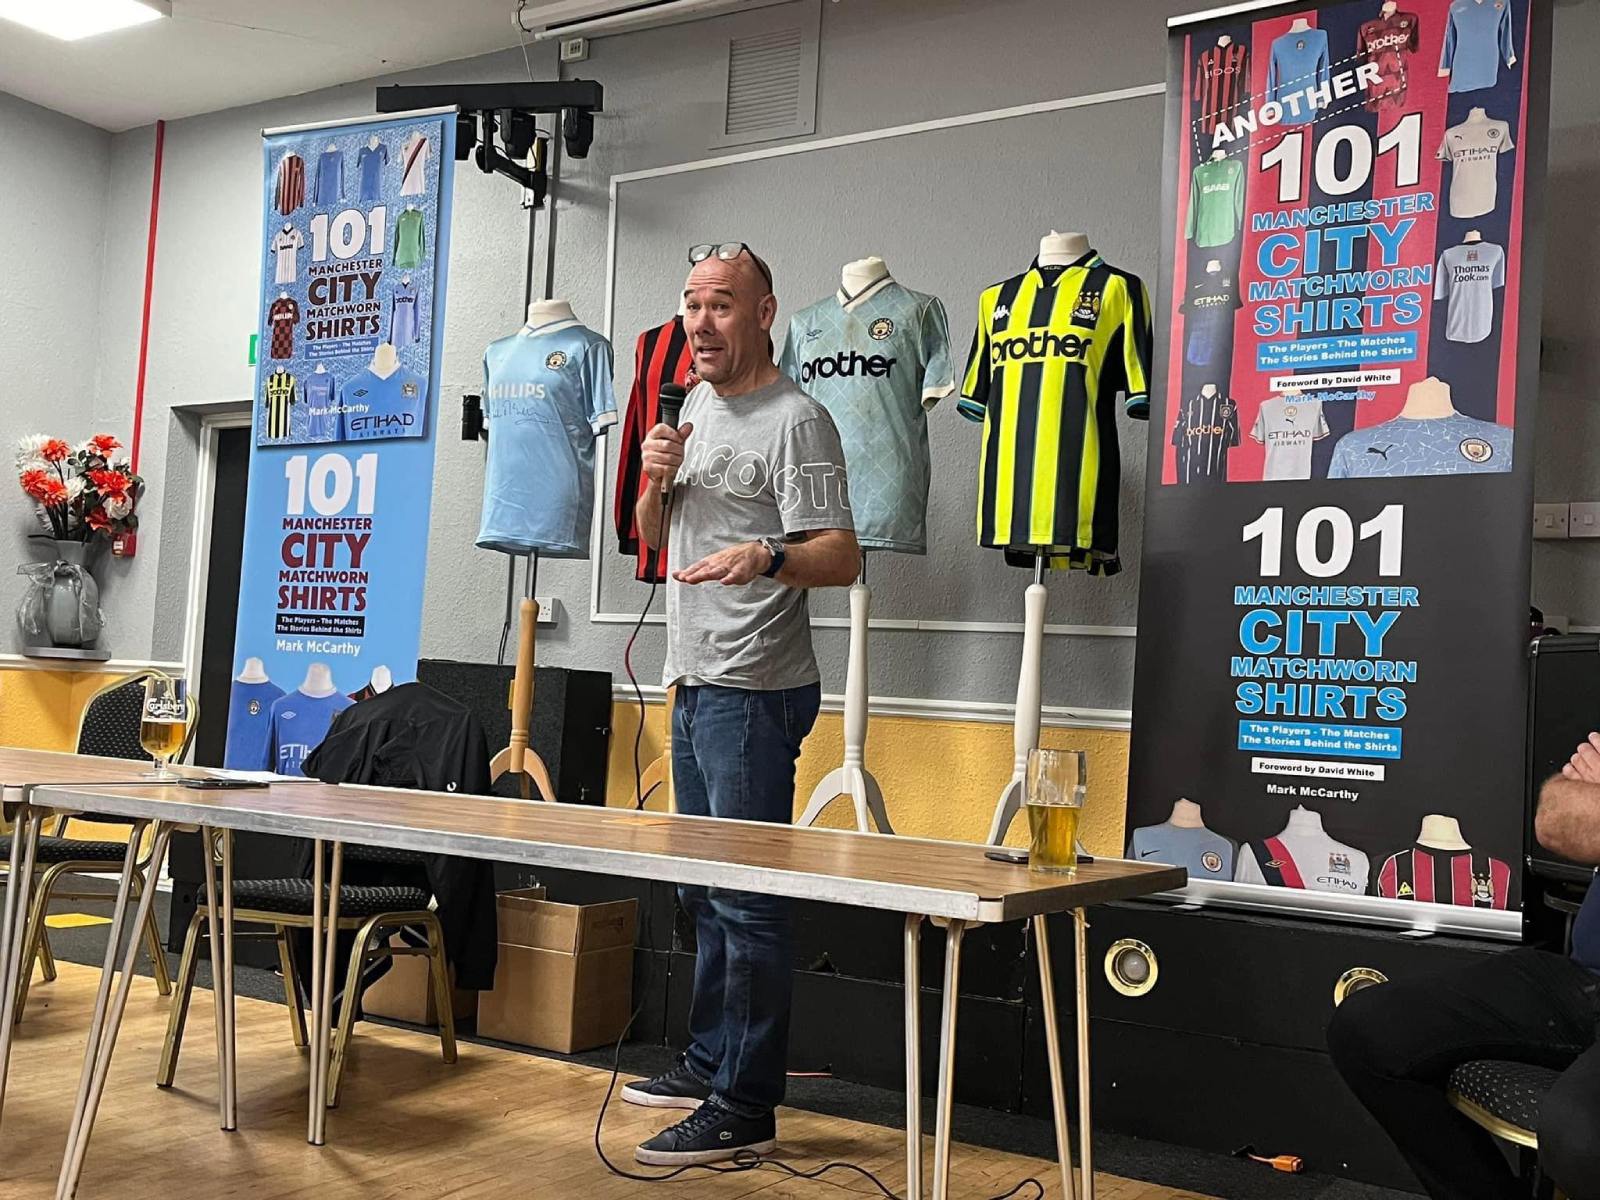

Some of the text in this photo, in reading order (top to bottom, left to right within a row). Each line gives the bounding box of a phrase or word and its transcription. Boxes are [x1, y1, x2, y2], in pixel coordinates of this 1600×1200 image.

[1212, 61, 1383, 149] ANOTHER
[1260, 112, 1423, 204] 101
[1252, 192, 1435, 232] MANCHESTER
[310, 205, 387, 262] 101
[1256, 218, 1417, 279] CITY
[308, 258, 383, 276] MANCHESTER
[1454, 264, 1490, 274] Thomas
[308, 271, 382, 306] CITY
[1249, 263, 1432, 302] MATCHWORN
[306, 302, 381, 319] MATCHWORN
[1253, 291, 1423, 337] SHIRTS
[306, 315, 380, 341] SHIRTS
[1268, 345, 1287, 354] The
[1290, 343, 1328, 354] Players
[1337, 340, 1357, 348] The
[1360, 336, 1406, 347] Matches
[1260, 346, 1413, 365] The Stories Behind the Shirts
[802, 350, 897, 384] brother
[1276, 373, 1392, 389] Foreword By David White
[490, 383, 546, 399] HILIPS
[1284, 389, 1376, 404] Mark McCarthy
[309, 403, 370, 417] Mark McCarthy
[351, 413, 415, 431] ETIHAD
[1268, 429, 1311, 440] ETIHAD
[285, 453, 379, 516] 101
[282, 517, 373, 531] MANCHESTER
[1242, 504, 1404, 578] 101
[281, 532, 372, 569] CITY
[279, 570, 369, 584] MATCHWORN
[277, 585, 367, 612] SHIRTS
[1234, 586, 1420, 607] MANCHESTER
[289, 624, 310, 632] Stories
[311, 625, 332, 633] Behind
[345, 627, 362, 635] Shirts
[294, 616, 316, 625] Players
[334, 617, 359, 626] Matches
[1239, 608, 1402, 658] CITY
[276, 639, 361, 657] Mark McCarthy
[1230, 656, 1417, 683] MATCHWORN
[1235, 681, 1408, 722] SHIRTS
[1249, 724, 1269, 734] The
[1272, 725, 1311, 736] Players
[1320, 727, 1341, 738] The
[1343, 729, 1390, 740] Matches
[1241, 735, 1398, 752] The Stories Behind the Shirts
[1259, 762, 1375, 778] Foreword by David White
[1266, 784, 1359, 802] Mark McCarthy
[1316, 876, 1358, 890] ETIHAD
